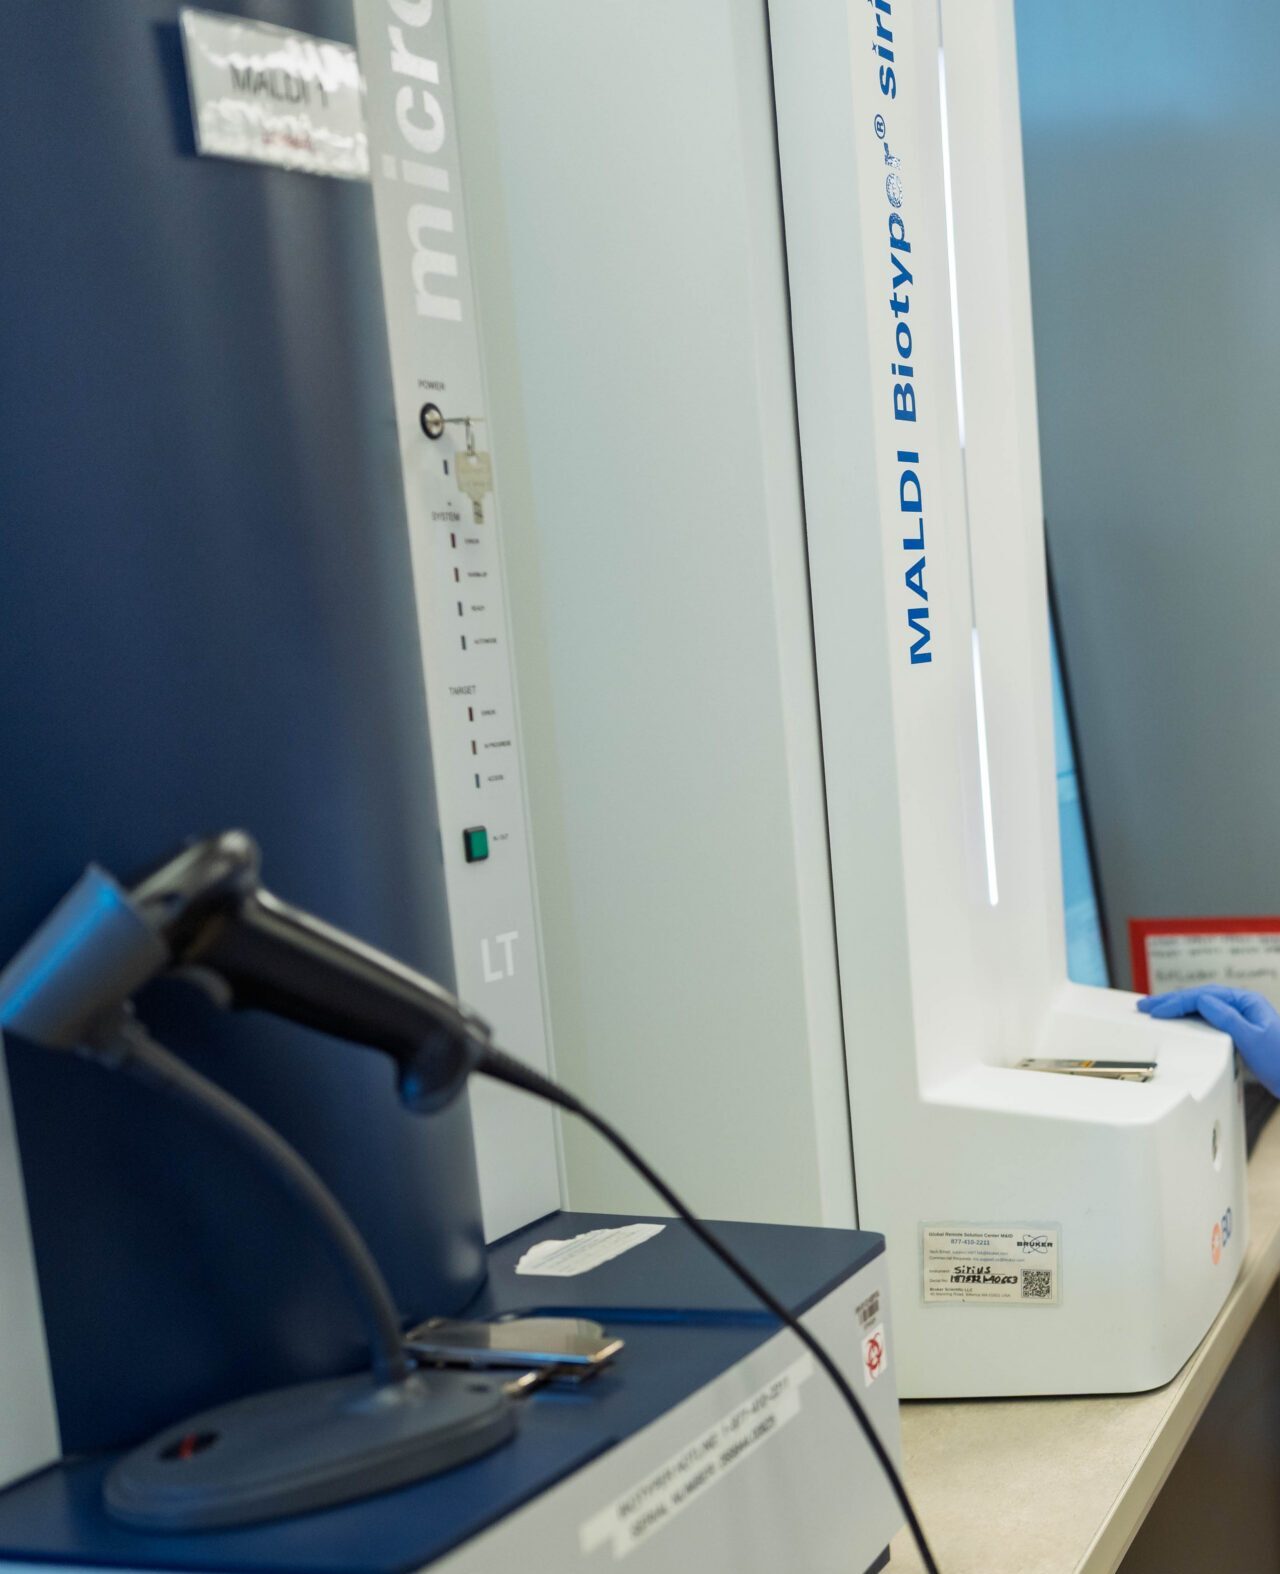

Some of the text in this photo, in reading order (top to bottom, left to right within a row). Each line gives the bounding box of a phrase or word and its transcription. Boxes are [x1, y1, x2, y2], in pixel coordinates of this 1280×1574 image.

[418, 379, 445, 391] POWER
[432, 511, 460, 521] SYSTEM
[897, 450, 932, 664] MALDI
[449, 685, 476, 695] TARGET
[480, 930, 518, 983] LT
